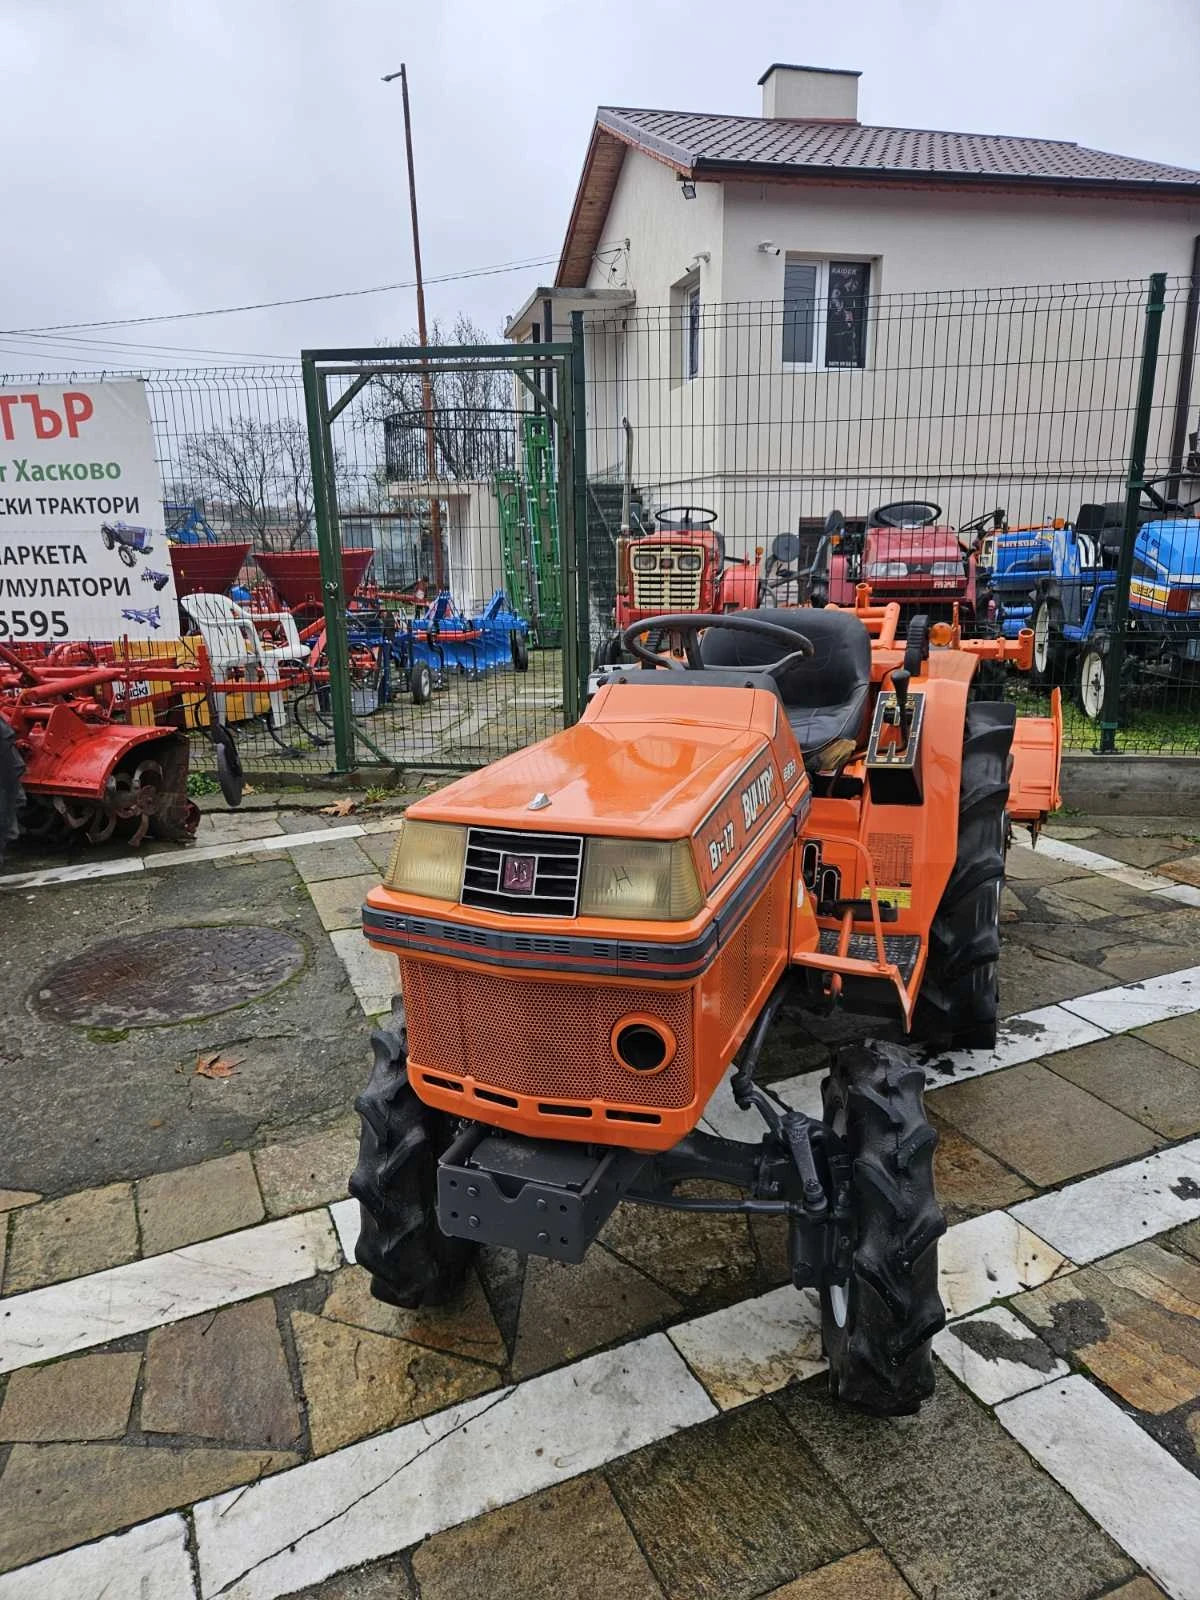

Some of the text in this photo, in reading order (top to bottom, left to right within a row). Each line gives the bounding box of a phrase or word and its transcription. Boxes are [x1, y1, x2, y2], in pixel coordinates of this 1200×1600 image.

[0, 392, 93, 440] ТЪР
[12, 459, 121, 482] Хасково
[36, 497, 140, 515] ТРАКТОРИ
[0, 545, 87, 565] АРКЕТА
